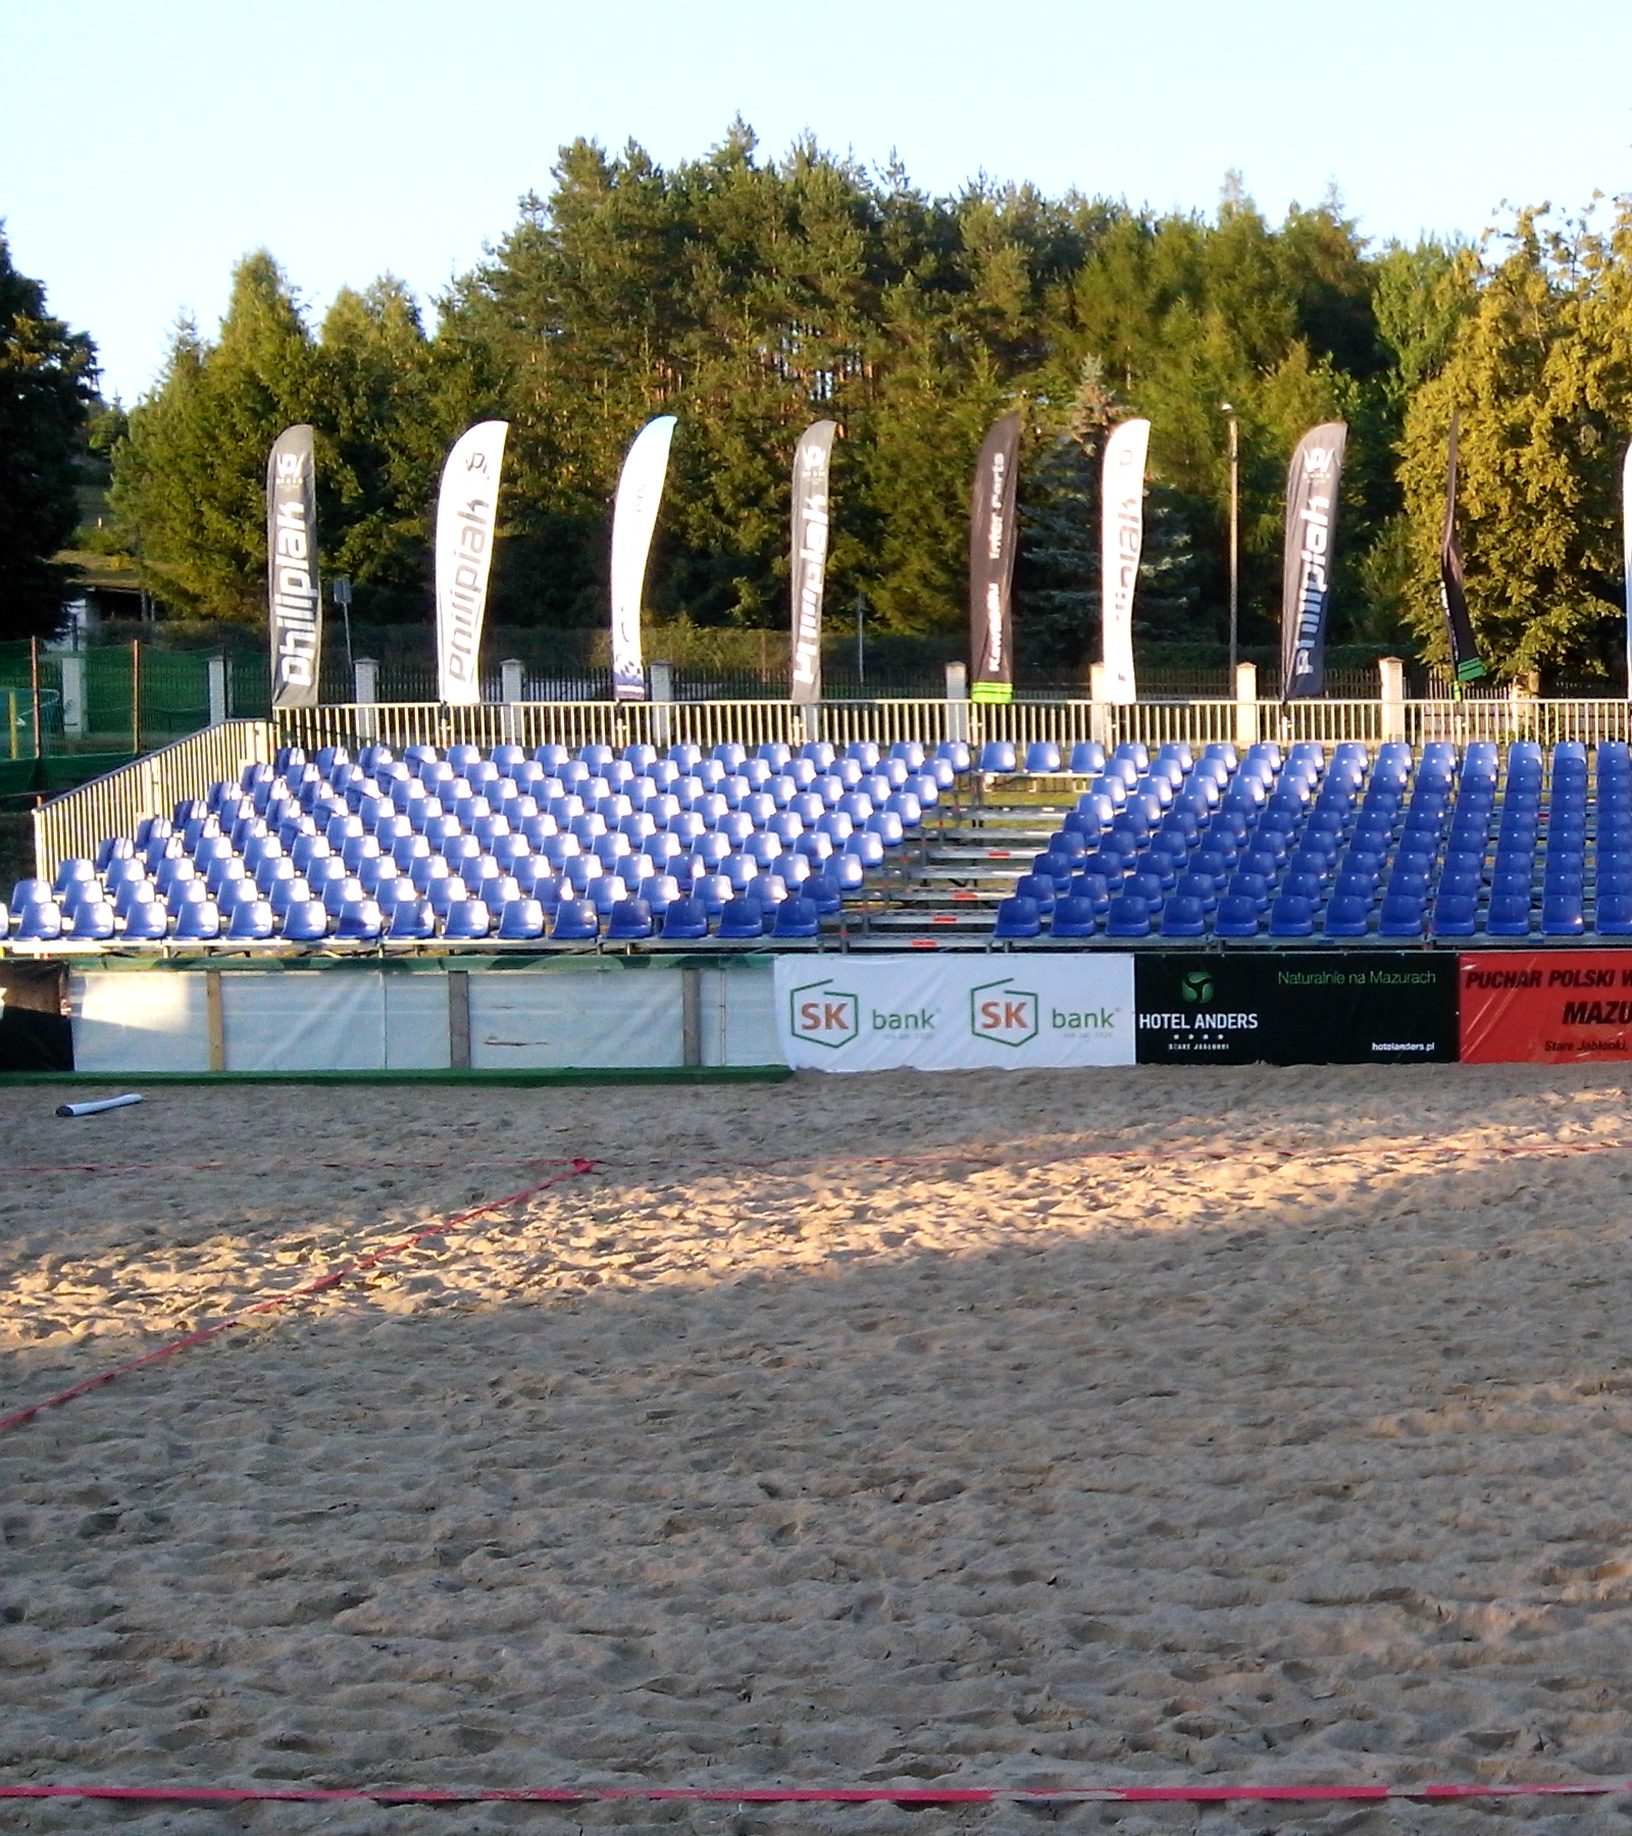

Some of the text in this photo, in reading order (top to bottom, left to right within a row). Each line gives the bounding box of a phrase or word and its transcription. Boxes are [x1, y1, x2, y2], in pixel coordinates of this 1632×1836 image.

[1278, 970, 1436, 985] Naturalnie na Mazurach
[1465, 970, 1544, 989] PUCHAR
[1548, 969, 1616, 988] POLSKI
[801, 1002, 936, 1031] SK bank
[981, 1001, 1115, 1030] SK bank
[1139, 1013, 1258, 1029] HOTEL ANDERS
[1371, 1042, 1435, 1052] hotelanders.pl
[1544, 1040, 1575, 1051] Stare
